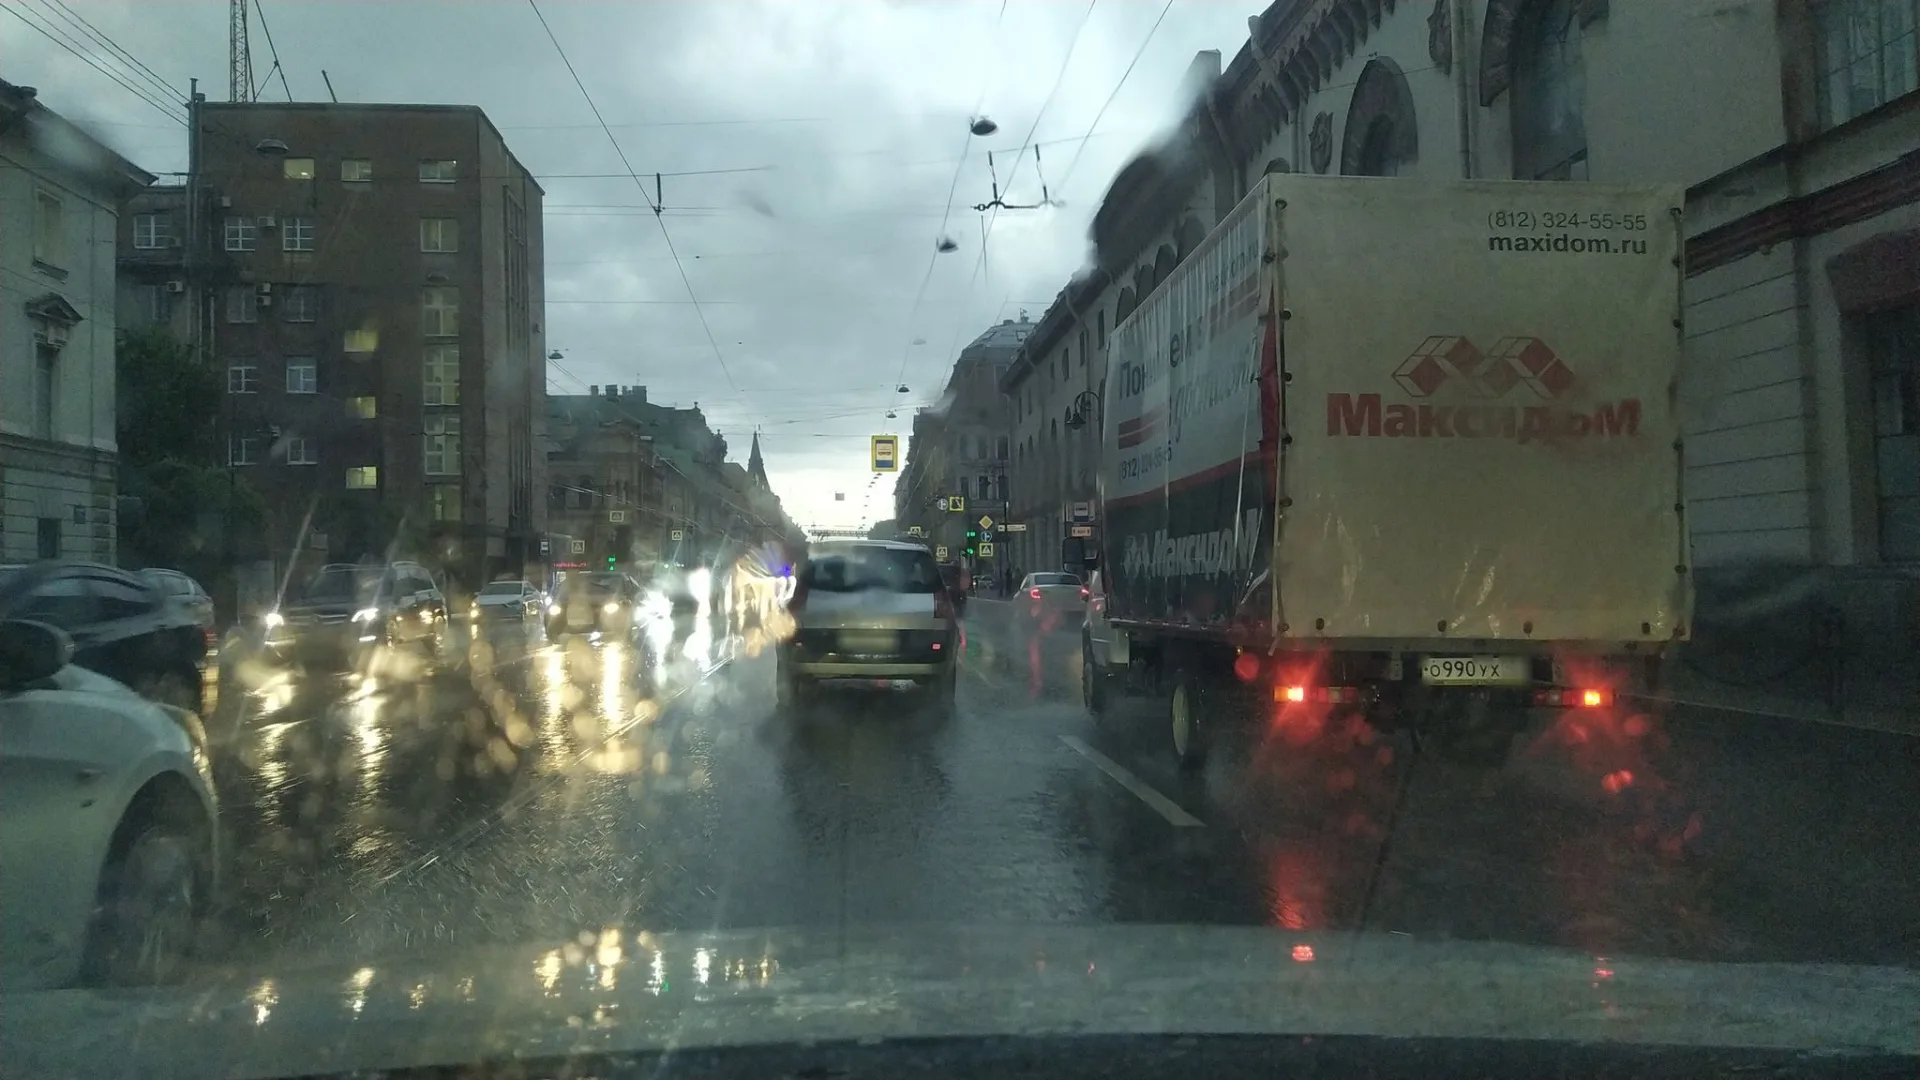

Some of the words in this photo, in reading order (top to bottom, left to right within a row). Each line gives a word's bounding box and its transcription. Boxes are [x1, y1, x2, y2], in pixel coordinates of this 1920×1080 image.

[1487, 212, 1537, 231] (812)
[1544, 212, 1647, 232] 324-55-55
[1489, 233, 1647, 255] maxidom.ru
